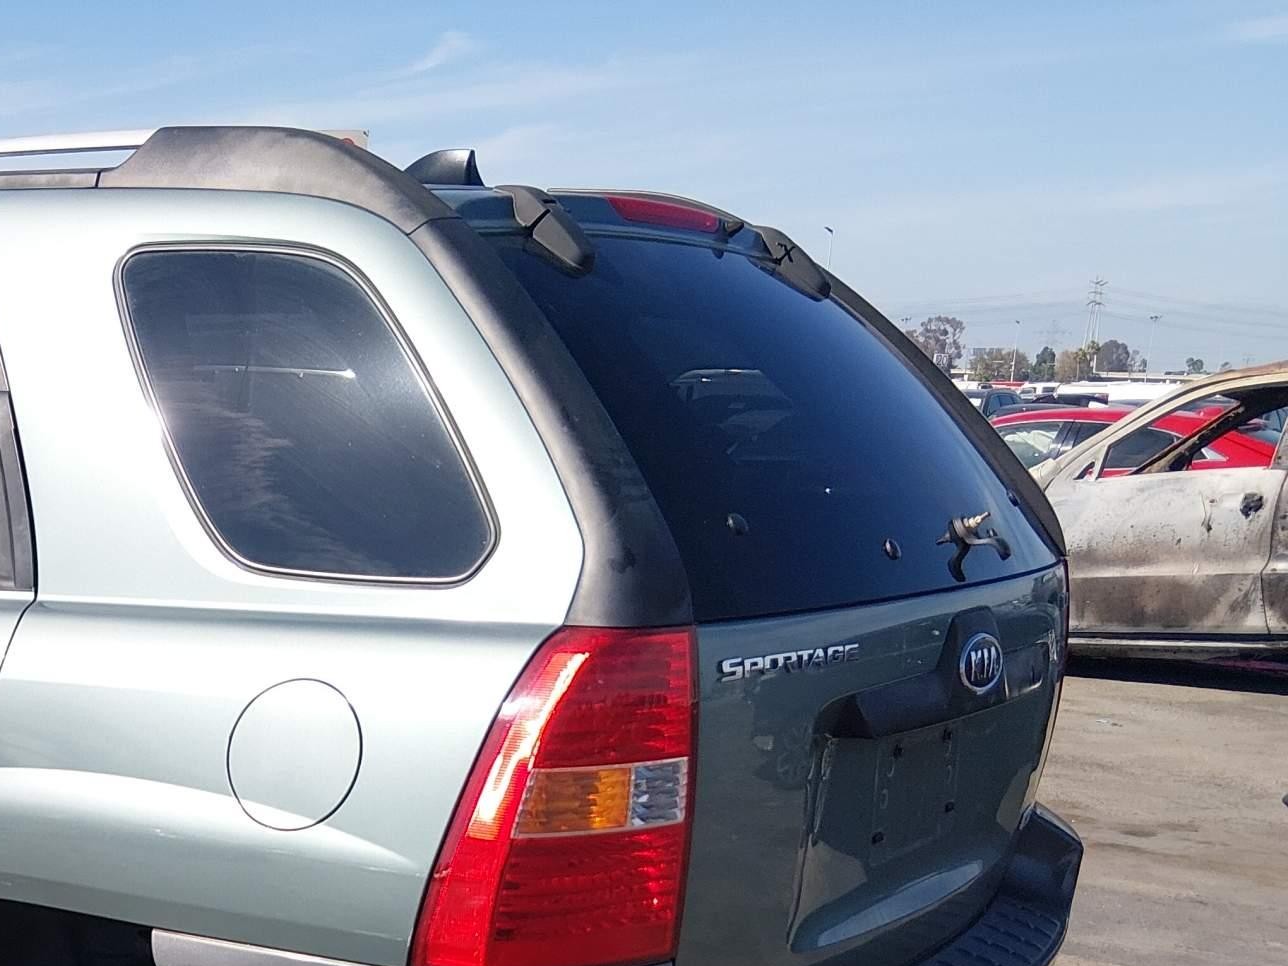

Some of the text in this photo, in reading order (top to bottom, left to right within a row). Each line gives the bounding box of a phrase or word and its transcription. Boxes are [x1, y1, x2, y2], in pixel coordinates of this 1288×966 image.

[935, 354, 948, 366] 20
[721, 643, 860, 682] SPORTAGE
[969, 645, 999, 682] KIA
